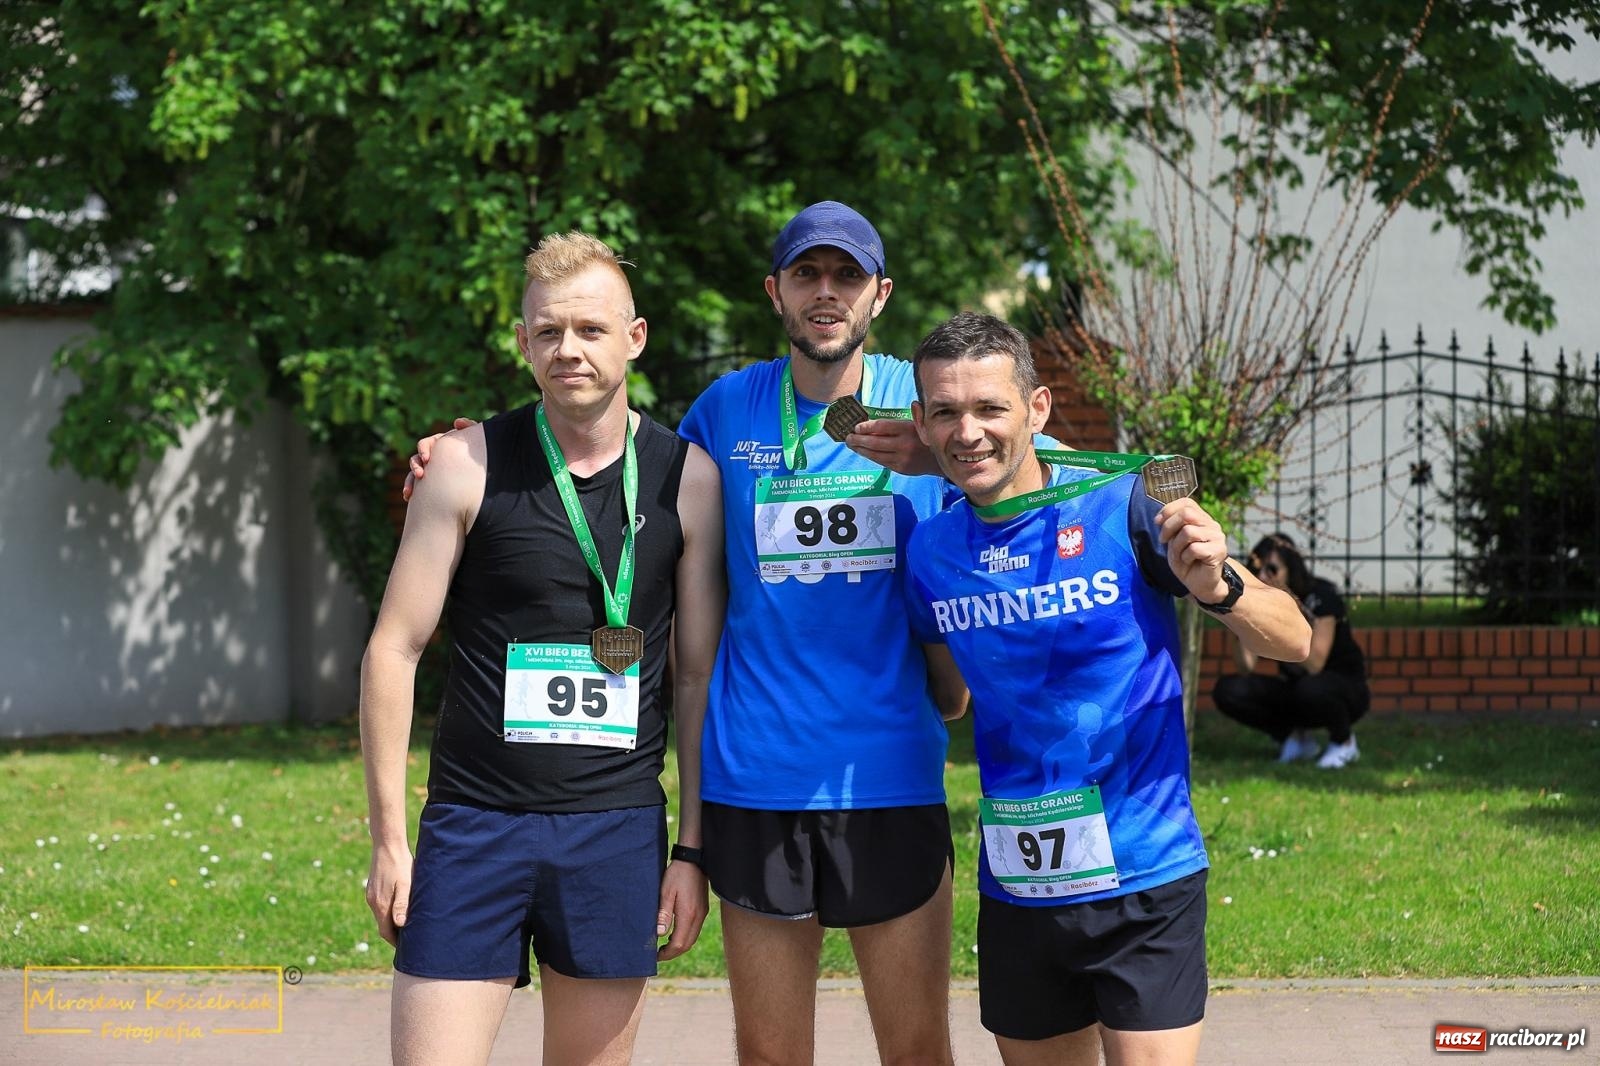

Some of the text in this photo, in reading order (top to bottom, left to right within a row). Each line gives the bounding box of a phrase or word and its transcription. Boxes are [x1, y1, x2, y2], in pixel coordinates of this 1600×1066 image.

[875, 410, 909, 419] Racibórz
[732, 441, 760, 452] JUST
[749, 452, 782, 463] TEAM
[771, 474, 874, 489] XVI BIEG BEZ GRANIC
[1028, 491, 1058, 503] Racibórz
[794, 504, 858, 547] 98
[931, 569, 1120, 633] RUNNERS
[525, 647, 591, 658] XVI BIEG BEZ
[547, 675, 608, 718] 95
[992, 793, 1084, 813] XVI BIEG BEZ GRANIC
[1017, 827, 1066, 871] 97
[1070, 881, 1098, 889] Racibórz
